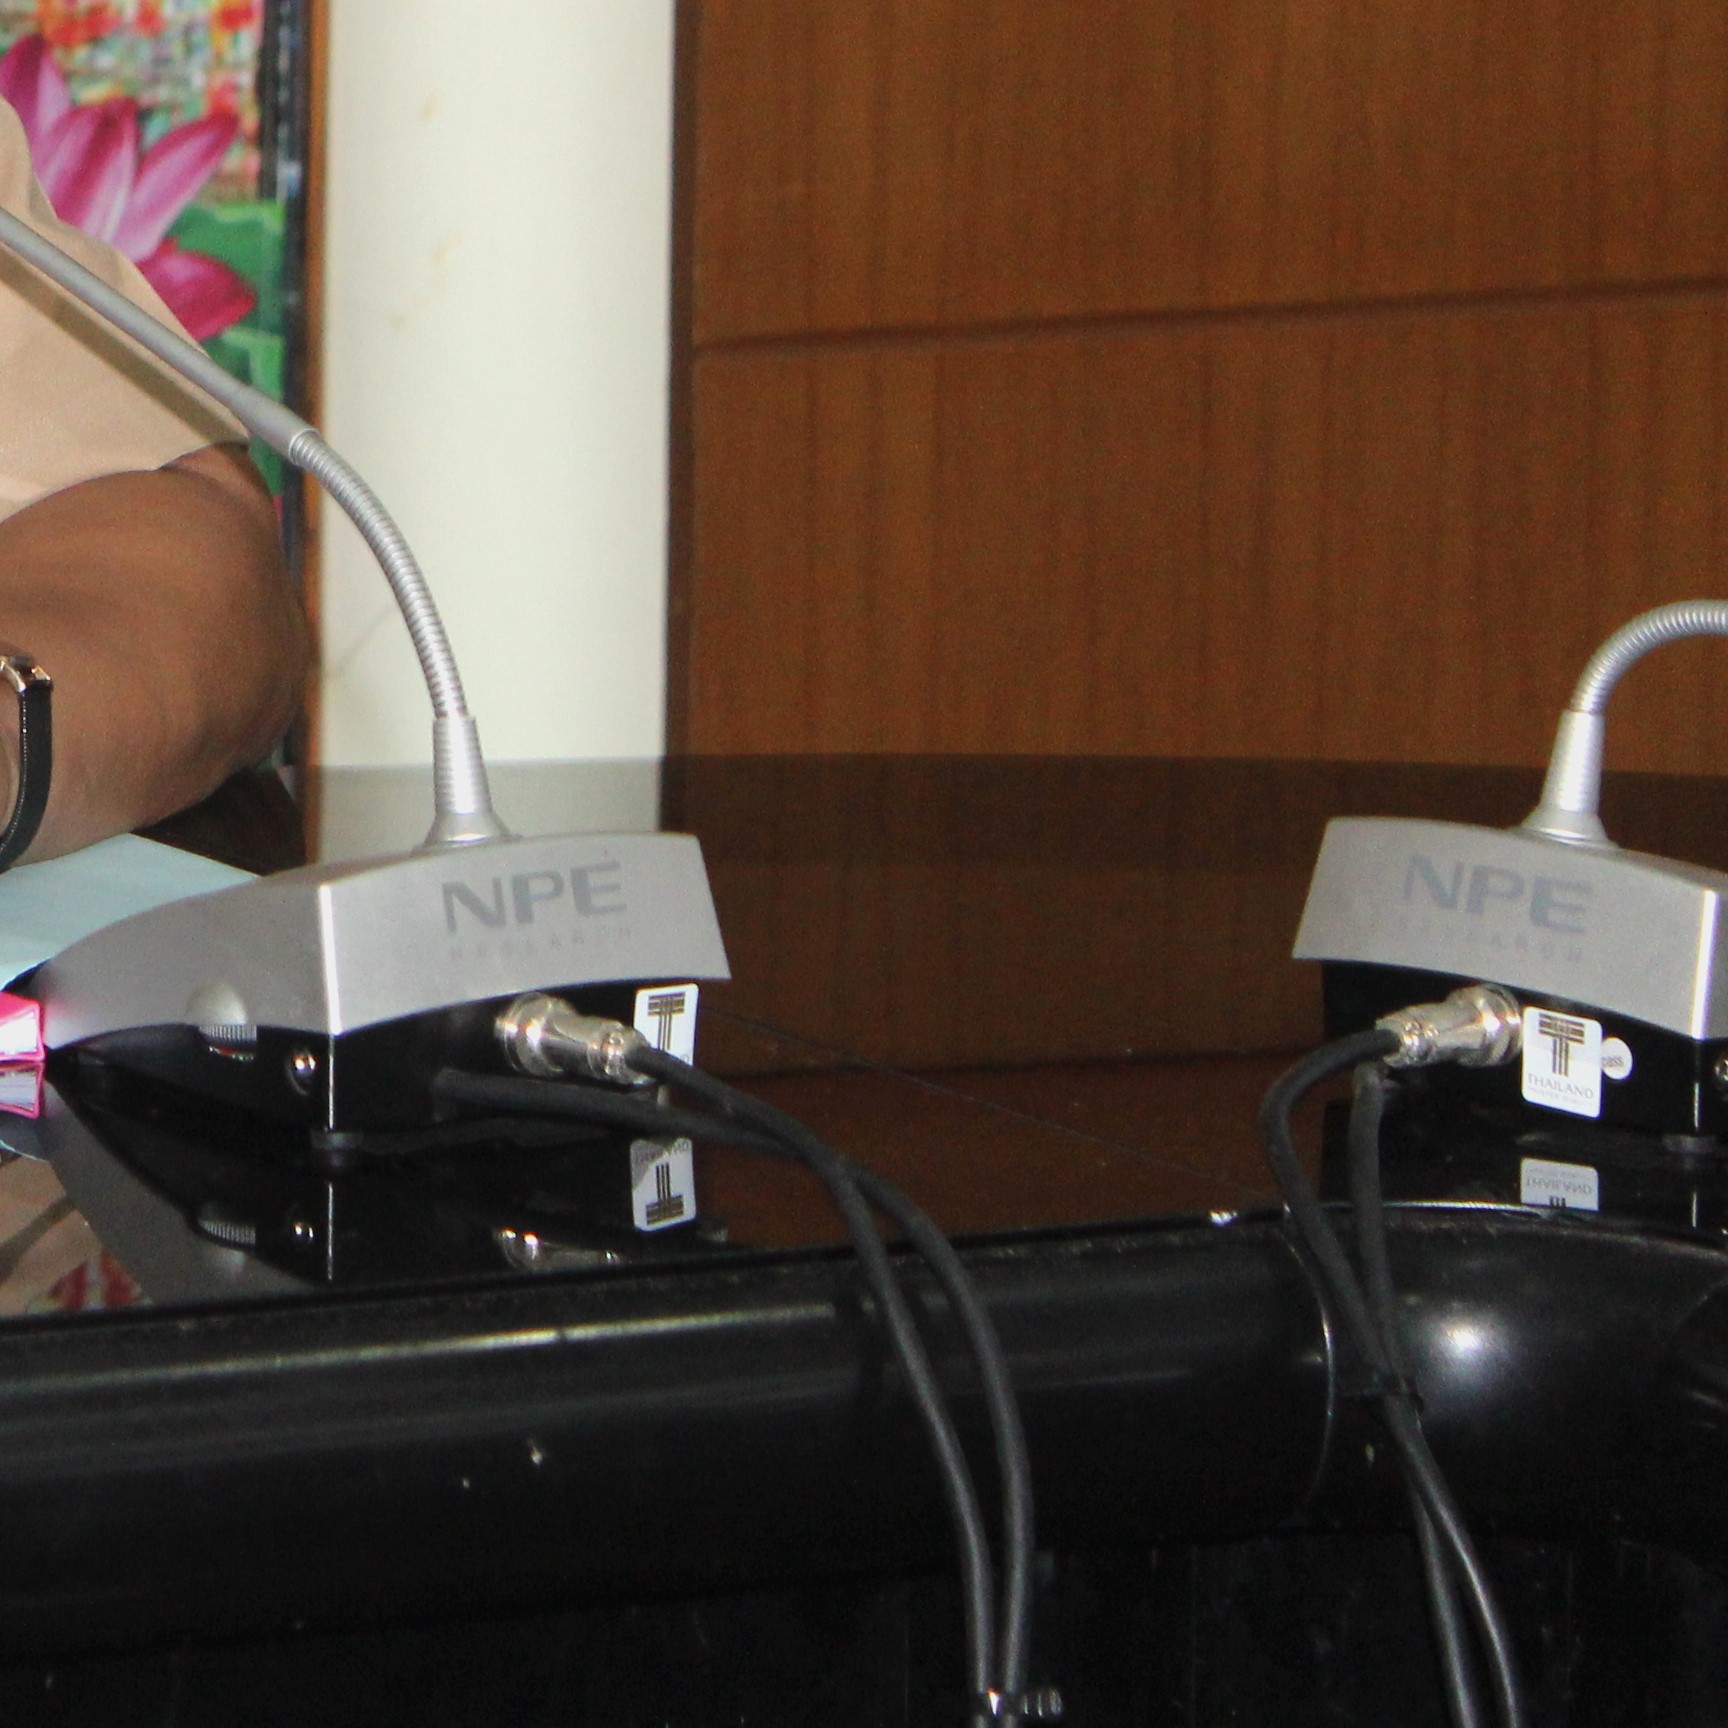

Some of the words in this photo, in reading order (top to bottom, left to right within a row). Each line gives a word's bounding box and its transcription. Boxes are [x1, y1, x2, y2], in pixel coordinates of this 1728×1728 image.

[442, 859, 627, 932] NPE
[1403, 854, 1592, 934] NPE
[1527, 1072, 1595, 1100] THAILAND
